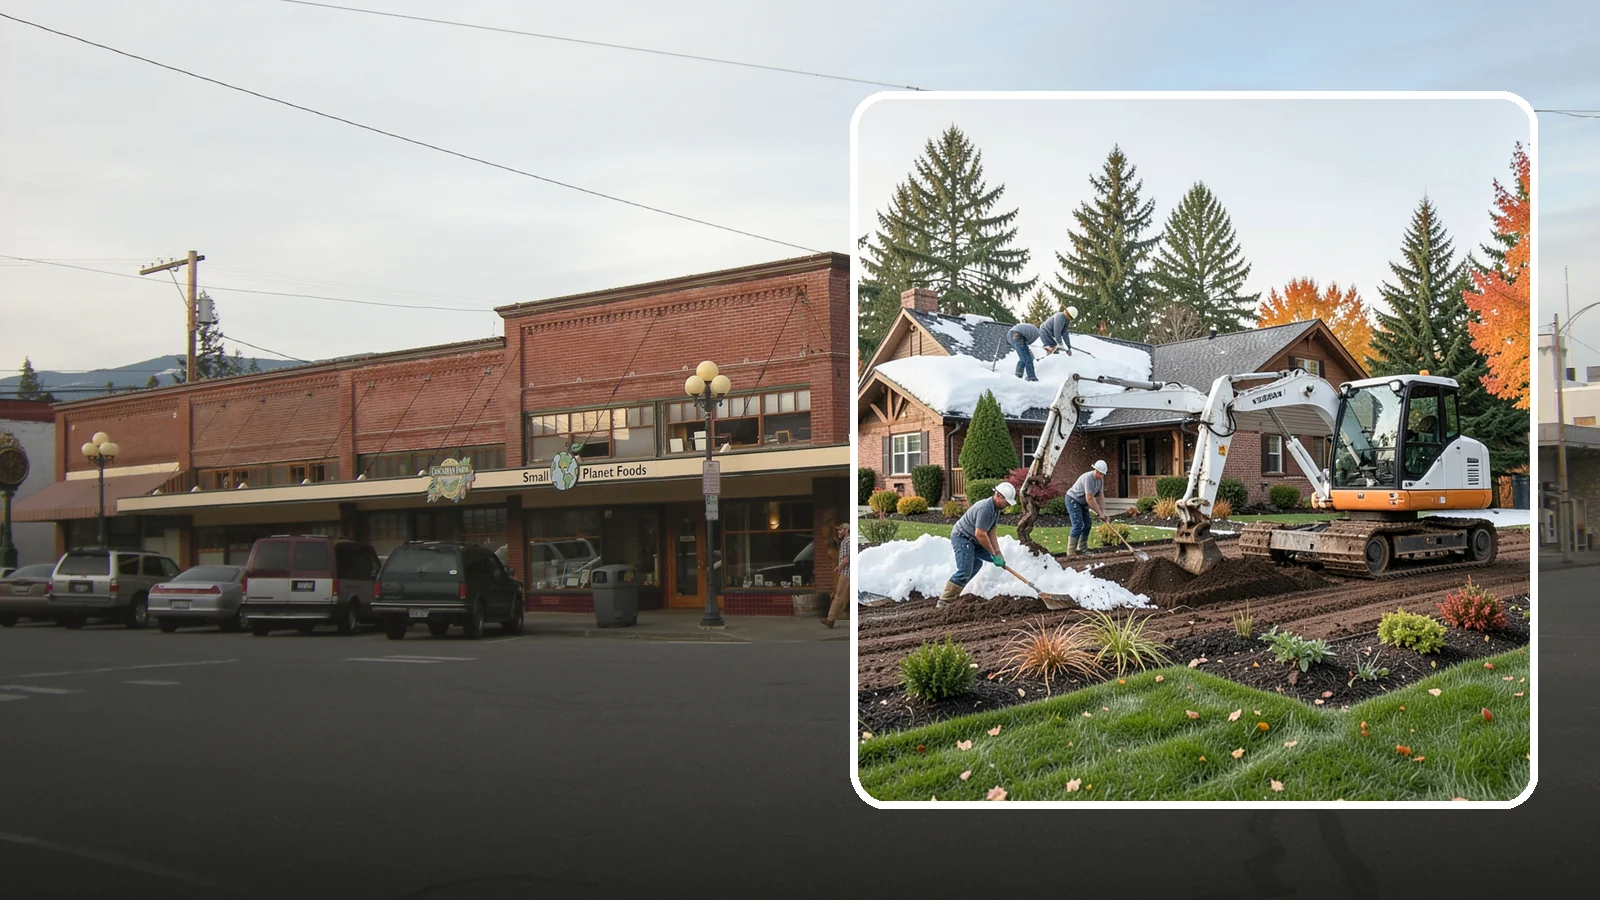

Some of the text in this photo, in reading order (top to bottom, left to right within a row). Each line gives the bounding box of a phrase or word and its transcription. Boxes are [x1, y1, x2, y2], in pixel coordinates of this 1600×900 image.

[523, 464, 647, 483] Small Planet Foods
